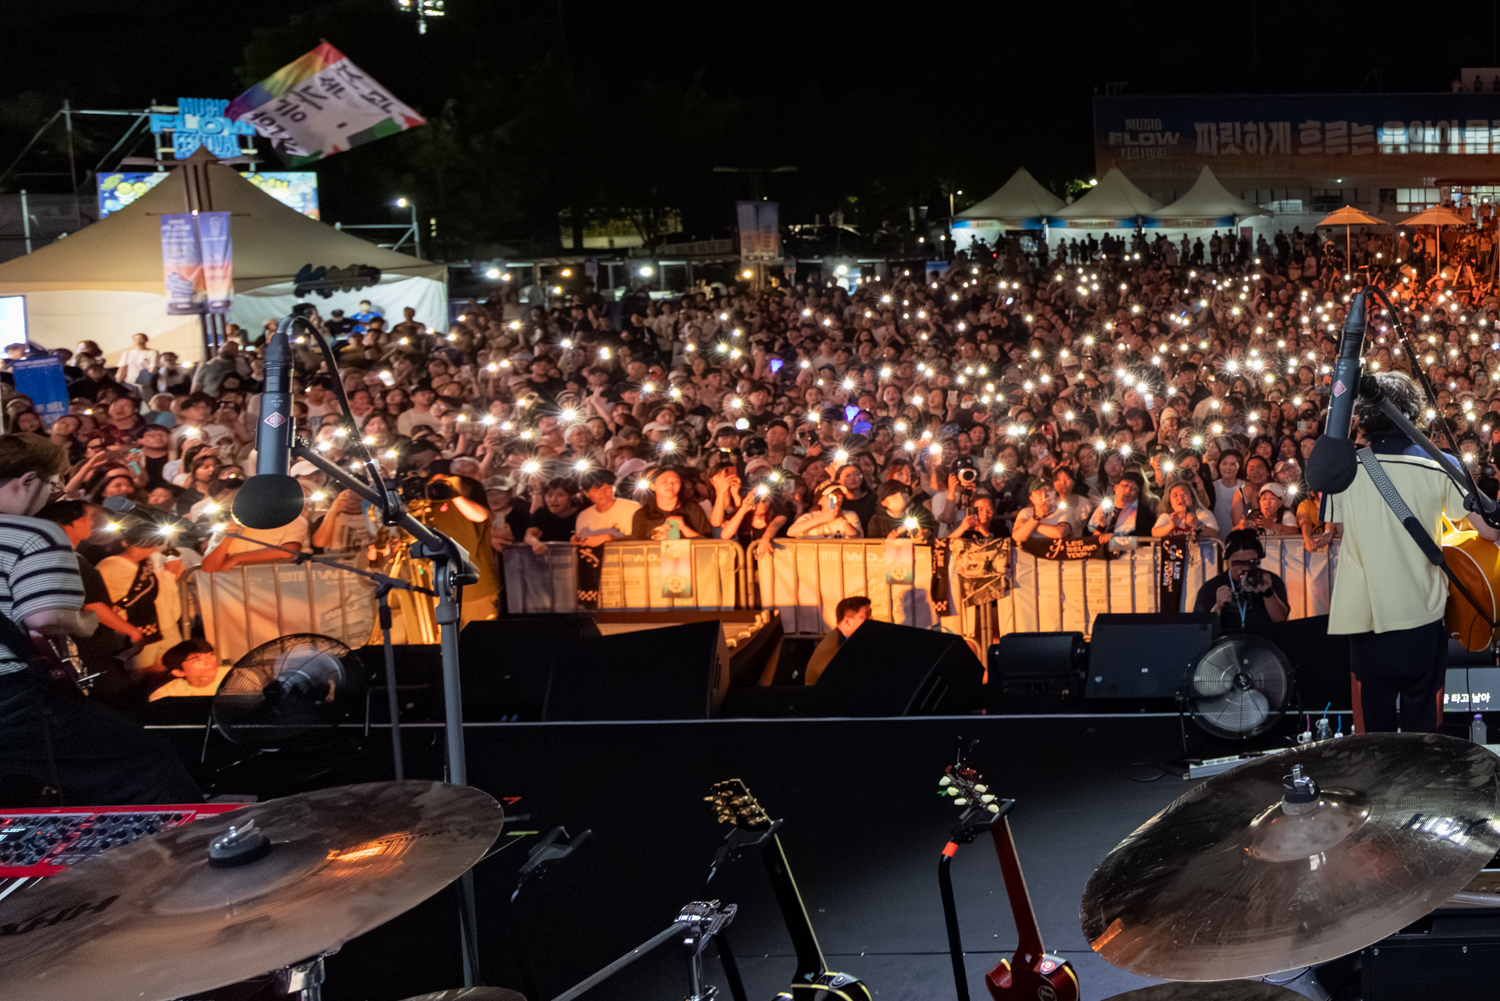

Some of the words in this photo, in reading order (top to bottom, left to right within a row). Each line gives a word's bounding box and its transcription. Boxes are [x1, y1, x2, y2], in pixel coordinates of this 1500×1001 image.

[150, 114, 255, 136] FLOW
[1108, 131, 1180, 146] FLOW
[1299, 120, 1375, 156] 흐르는
[1451, 693, 1470, 704] 타고
[1471, 692, 1491, 704] 날아
